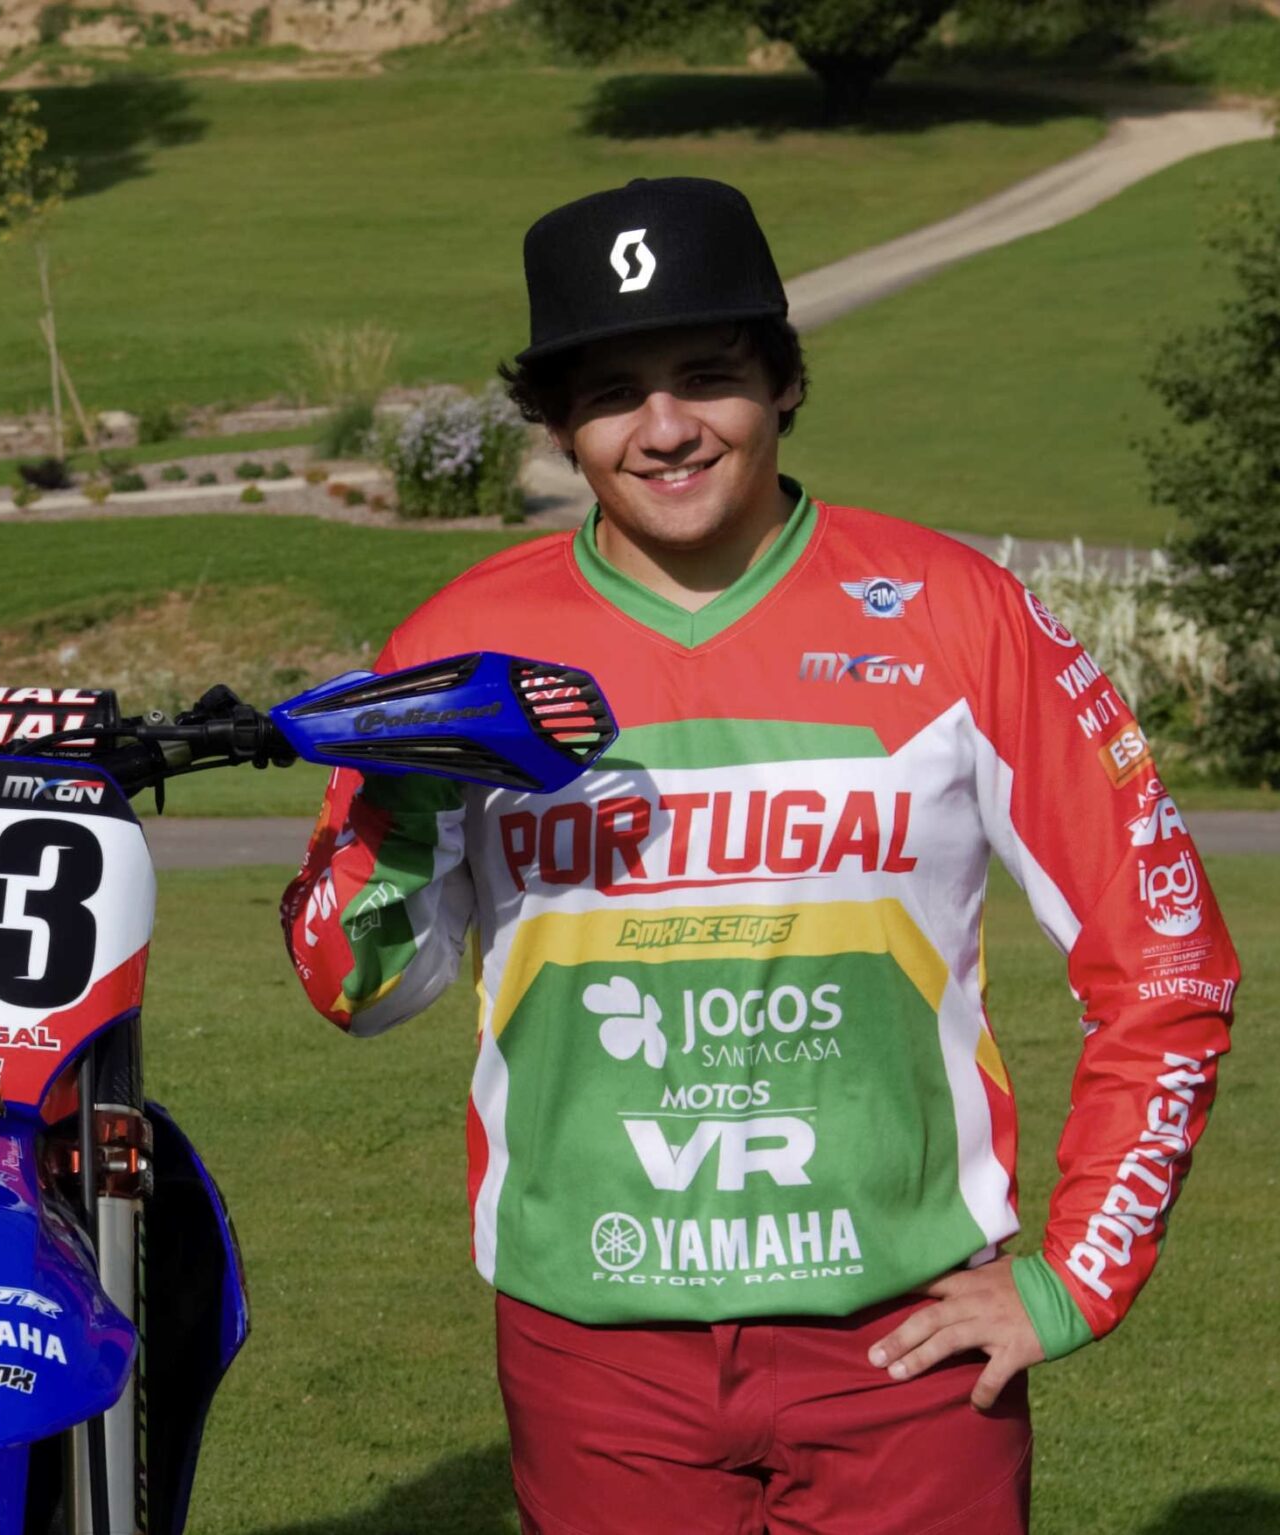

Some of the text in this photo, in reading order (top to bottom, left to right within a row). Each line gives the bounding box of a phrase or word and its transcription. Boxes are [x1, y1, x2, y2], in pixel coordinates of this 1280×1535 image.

[869, 587, 898, 607] FIM
[2, 775, 106, 804] MXON
[499, 789, 919, 897] PORTUGAL
[1138, 977, 1222, 1002] SILVESTRE
[681, 984, 842, 1055] JOGOS
[660, 1080, 770, 1110] MOTOS
[622, 1116, 816, 1192] VR
[651, 1208, 862, 1272] YAMAHA
[592, 1265, 864, 1286] FACTORY RACING
